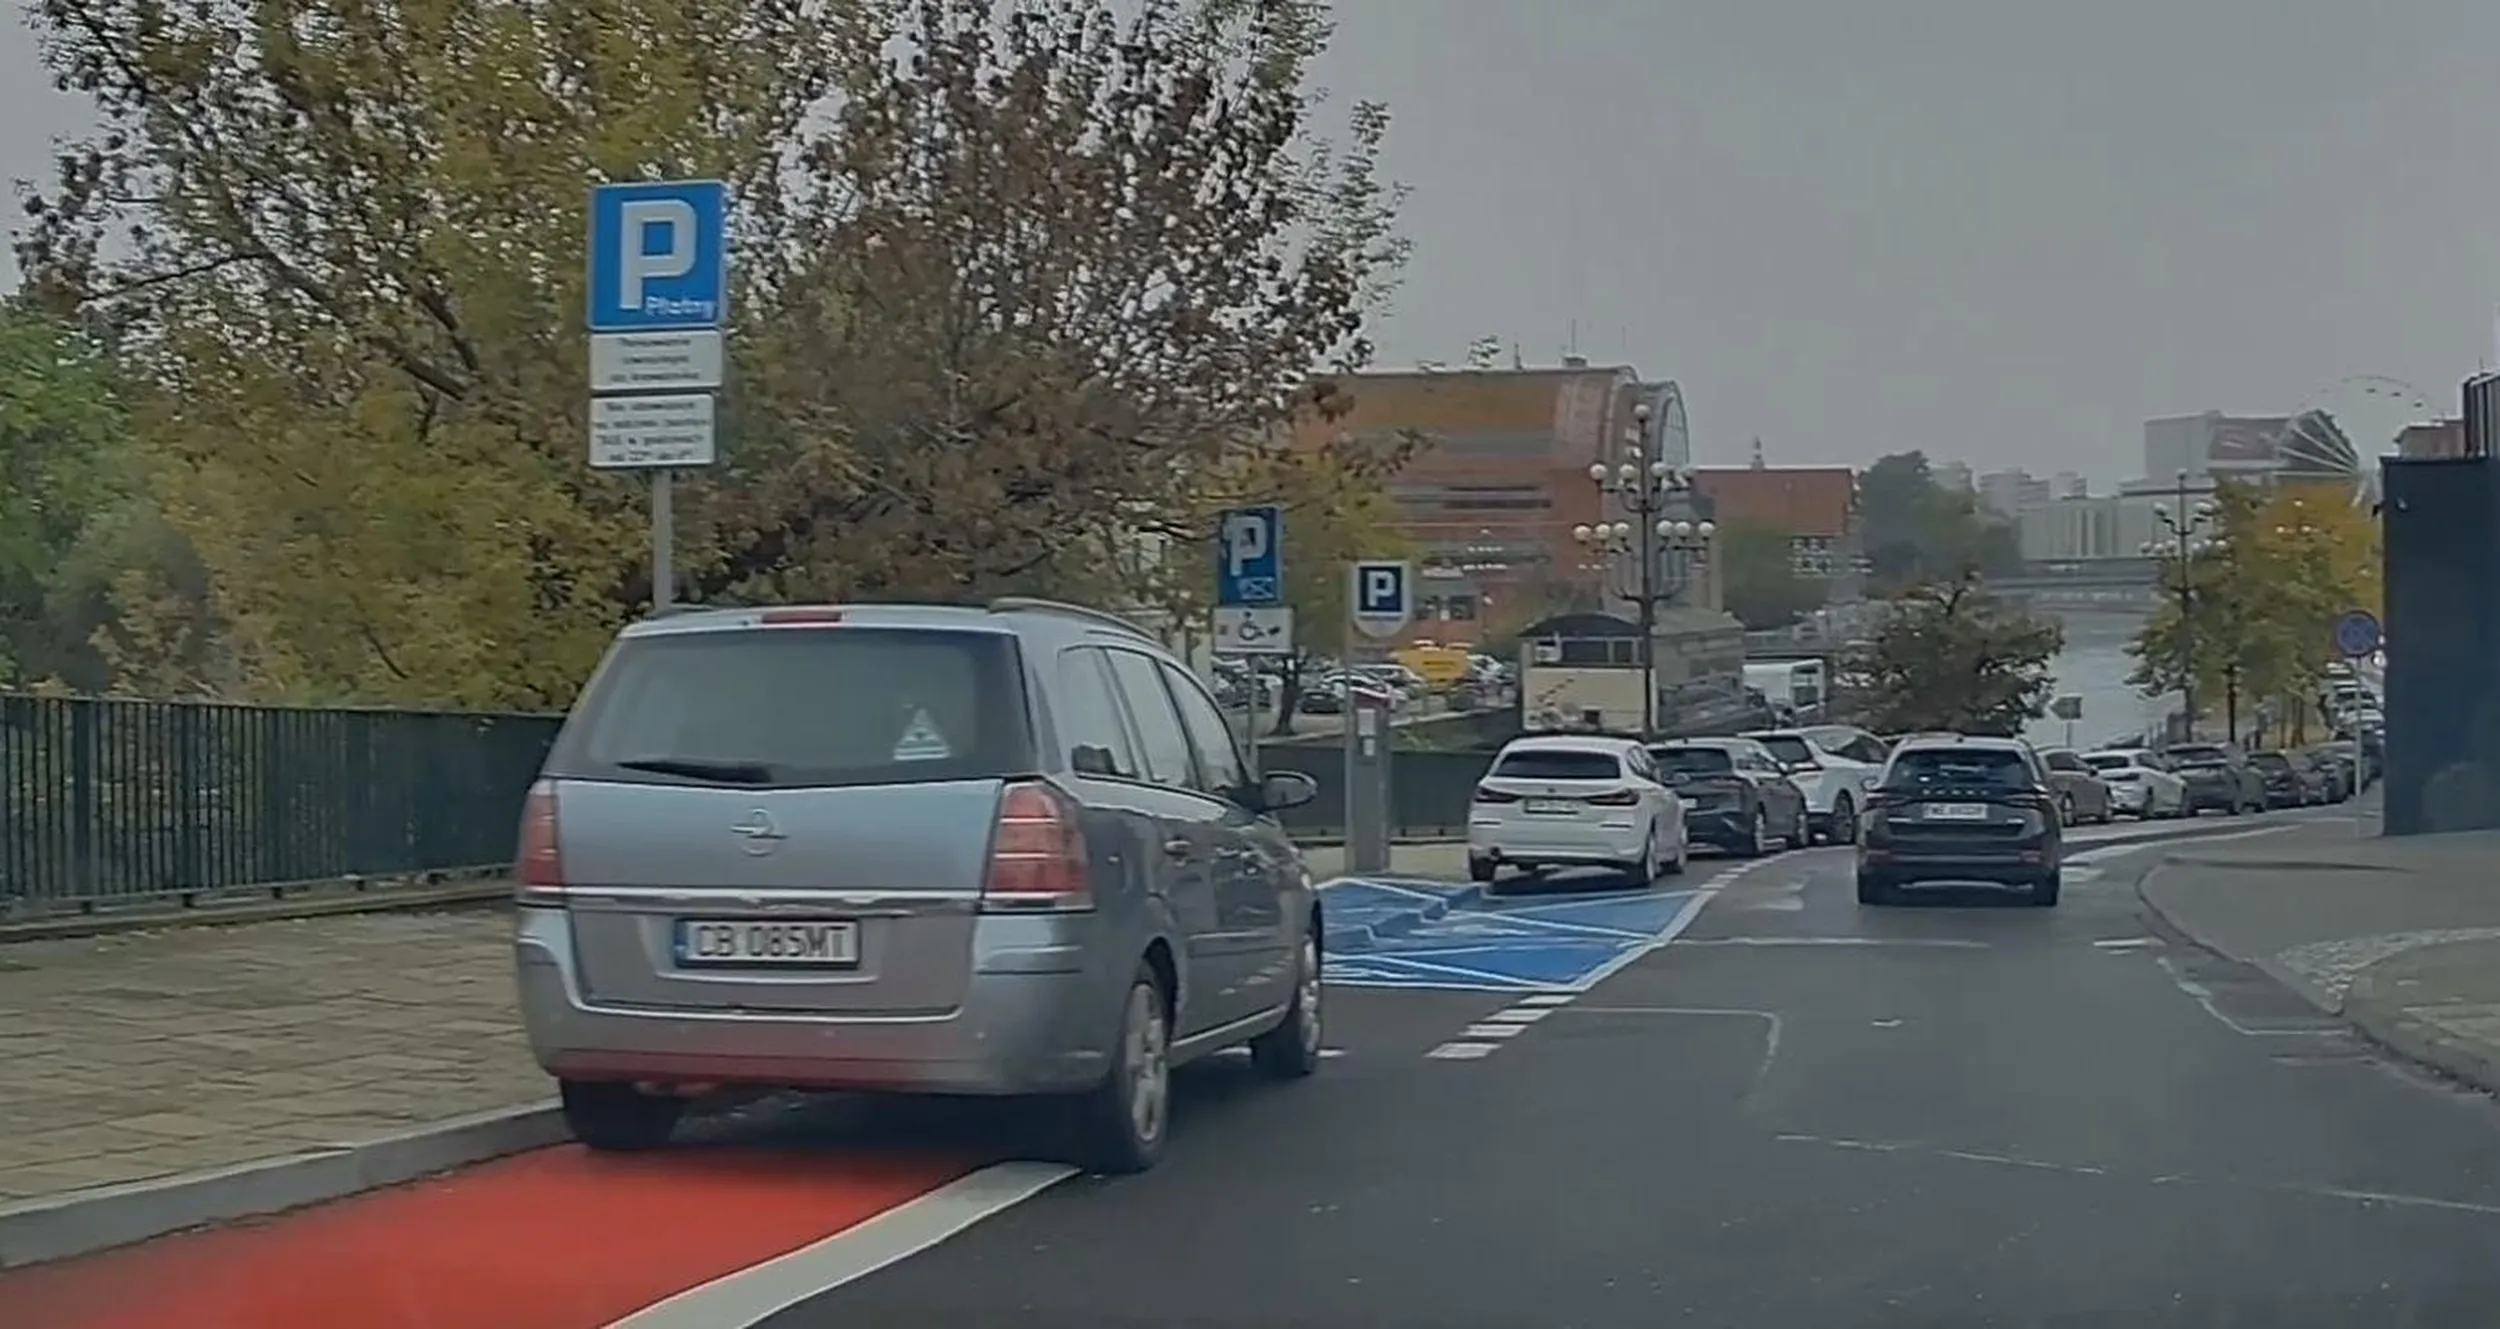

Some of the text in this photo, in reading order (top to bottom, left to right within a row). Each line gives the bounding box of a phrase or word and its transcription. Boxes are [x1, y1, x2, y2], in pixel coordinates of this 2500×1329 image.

[619, 199, 697, 309] P
[1229, 515, 1267, 577] P
[1366, 570, 1397, 607] P
[697, 925, 848, 957] CB 085MT
